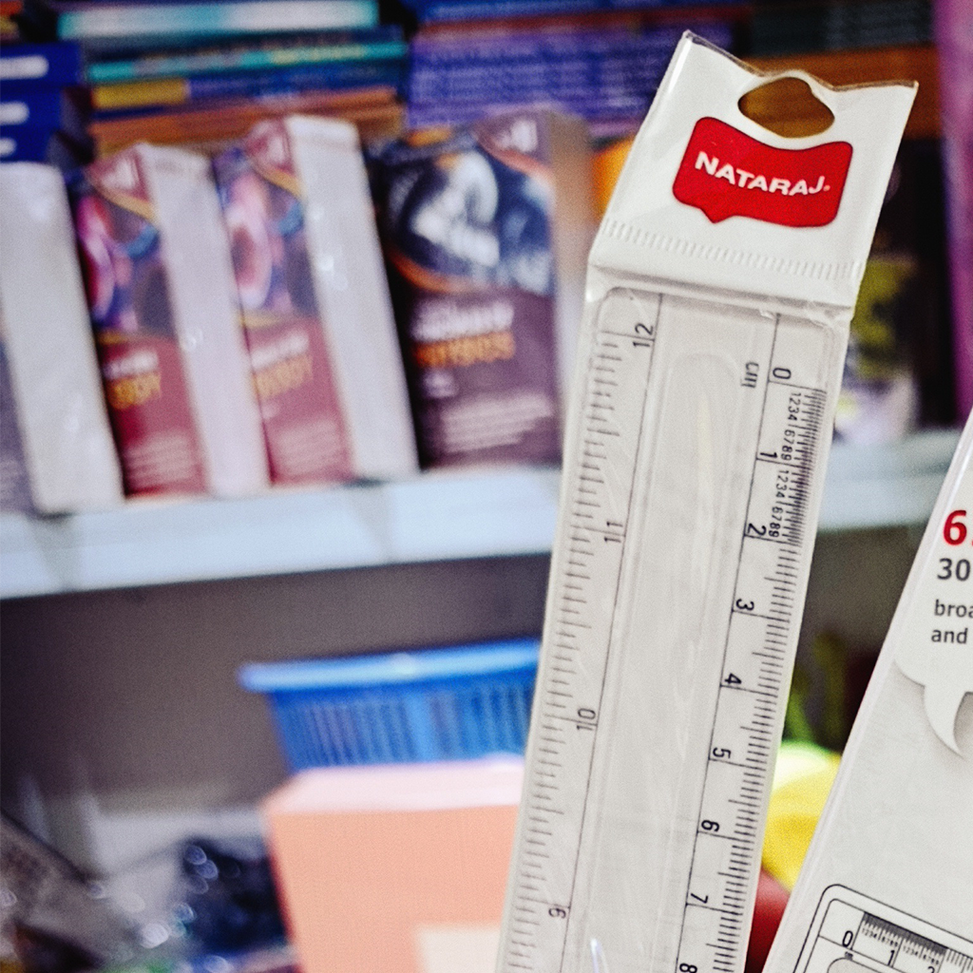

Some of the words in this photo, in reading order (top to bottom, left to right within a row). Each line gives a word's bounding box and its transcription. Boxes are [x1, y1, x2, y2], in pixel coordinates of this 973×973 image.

[695, 151, 825, 196] NATARAJ
[633, 323, 654, 348] 12
[773, 366, 791, 381] 0
[604, 521, 623, 543] 11
[747, 523, 767, 537] 2
[937, 558, 971, 582] 30
[736, 598, 755, 611] 3
[931, 627, 968, 644] and
[724, 673, 742, 685] 4
[576, 708, 596, 731] 10
[712, 747, 731, 759] 5
[701, 820, 720, 832] 6
[691, 892, 708, 904] 7
[842, 930, 854, 948] 0
